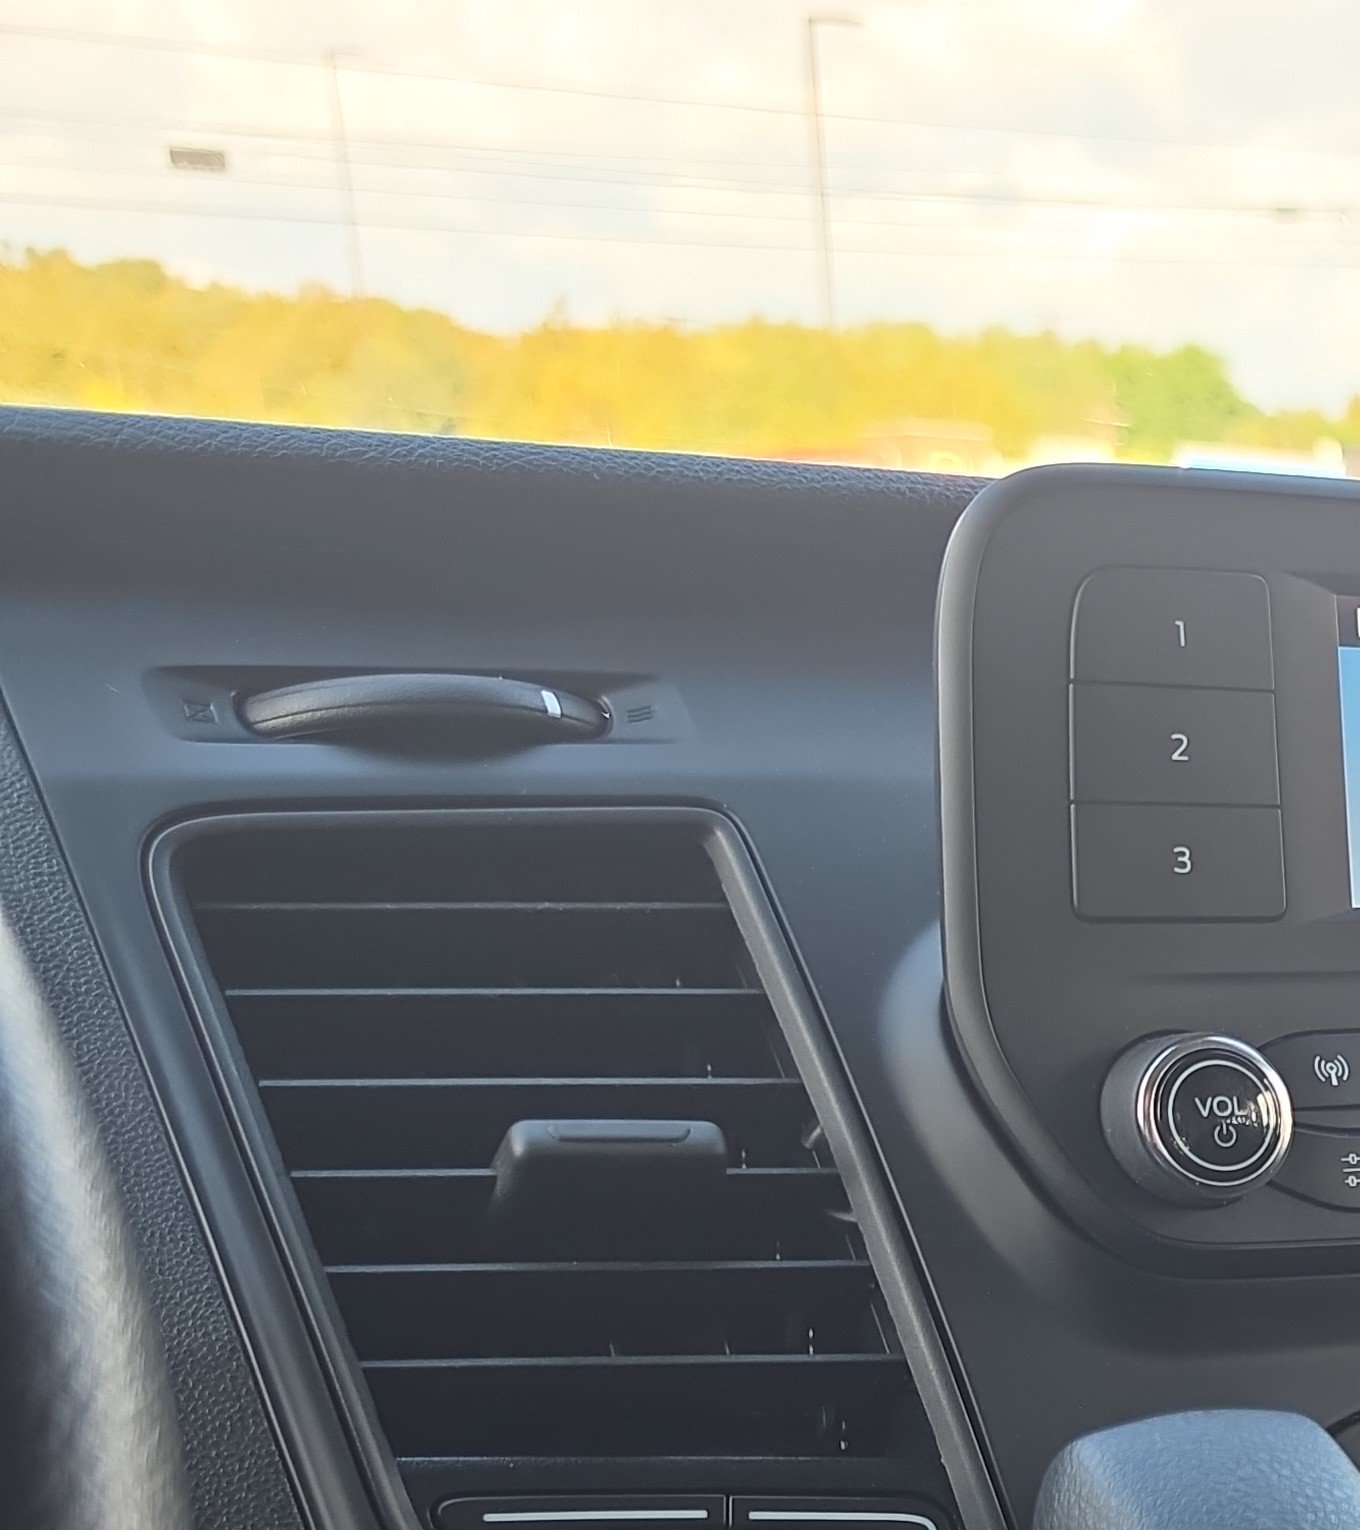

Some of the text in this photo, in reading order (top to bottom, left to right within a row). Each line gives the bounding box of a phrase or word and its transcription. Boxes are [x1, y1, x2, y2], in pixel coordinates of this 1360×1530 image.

[1174, 619, 1186, 647] 1
[1169, 733, 1189, 761] 2
[1172, 846, 1192, 874] 3
[1194, 1095, 1248, 1118] VOL
